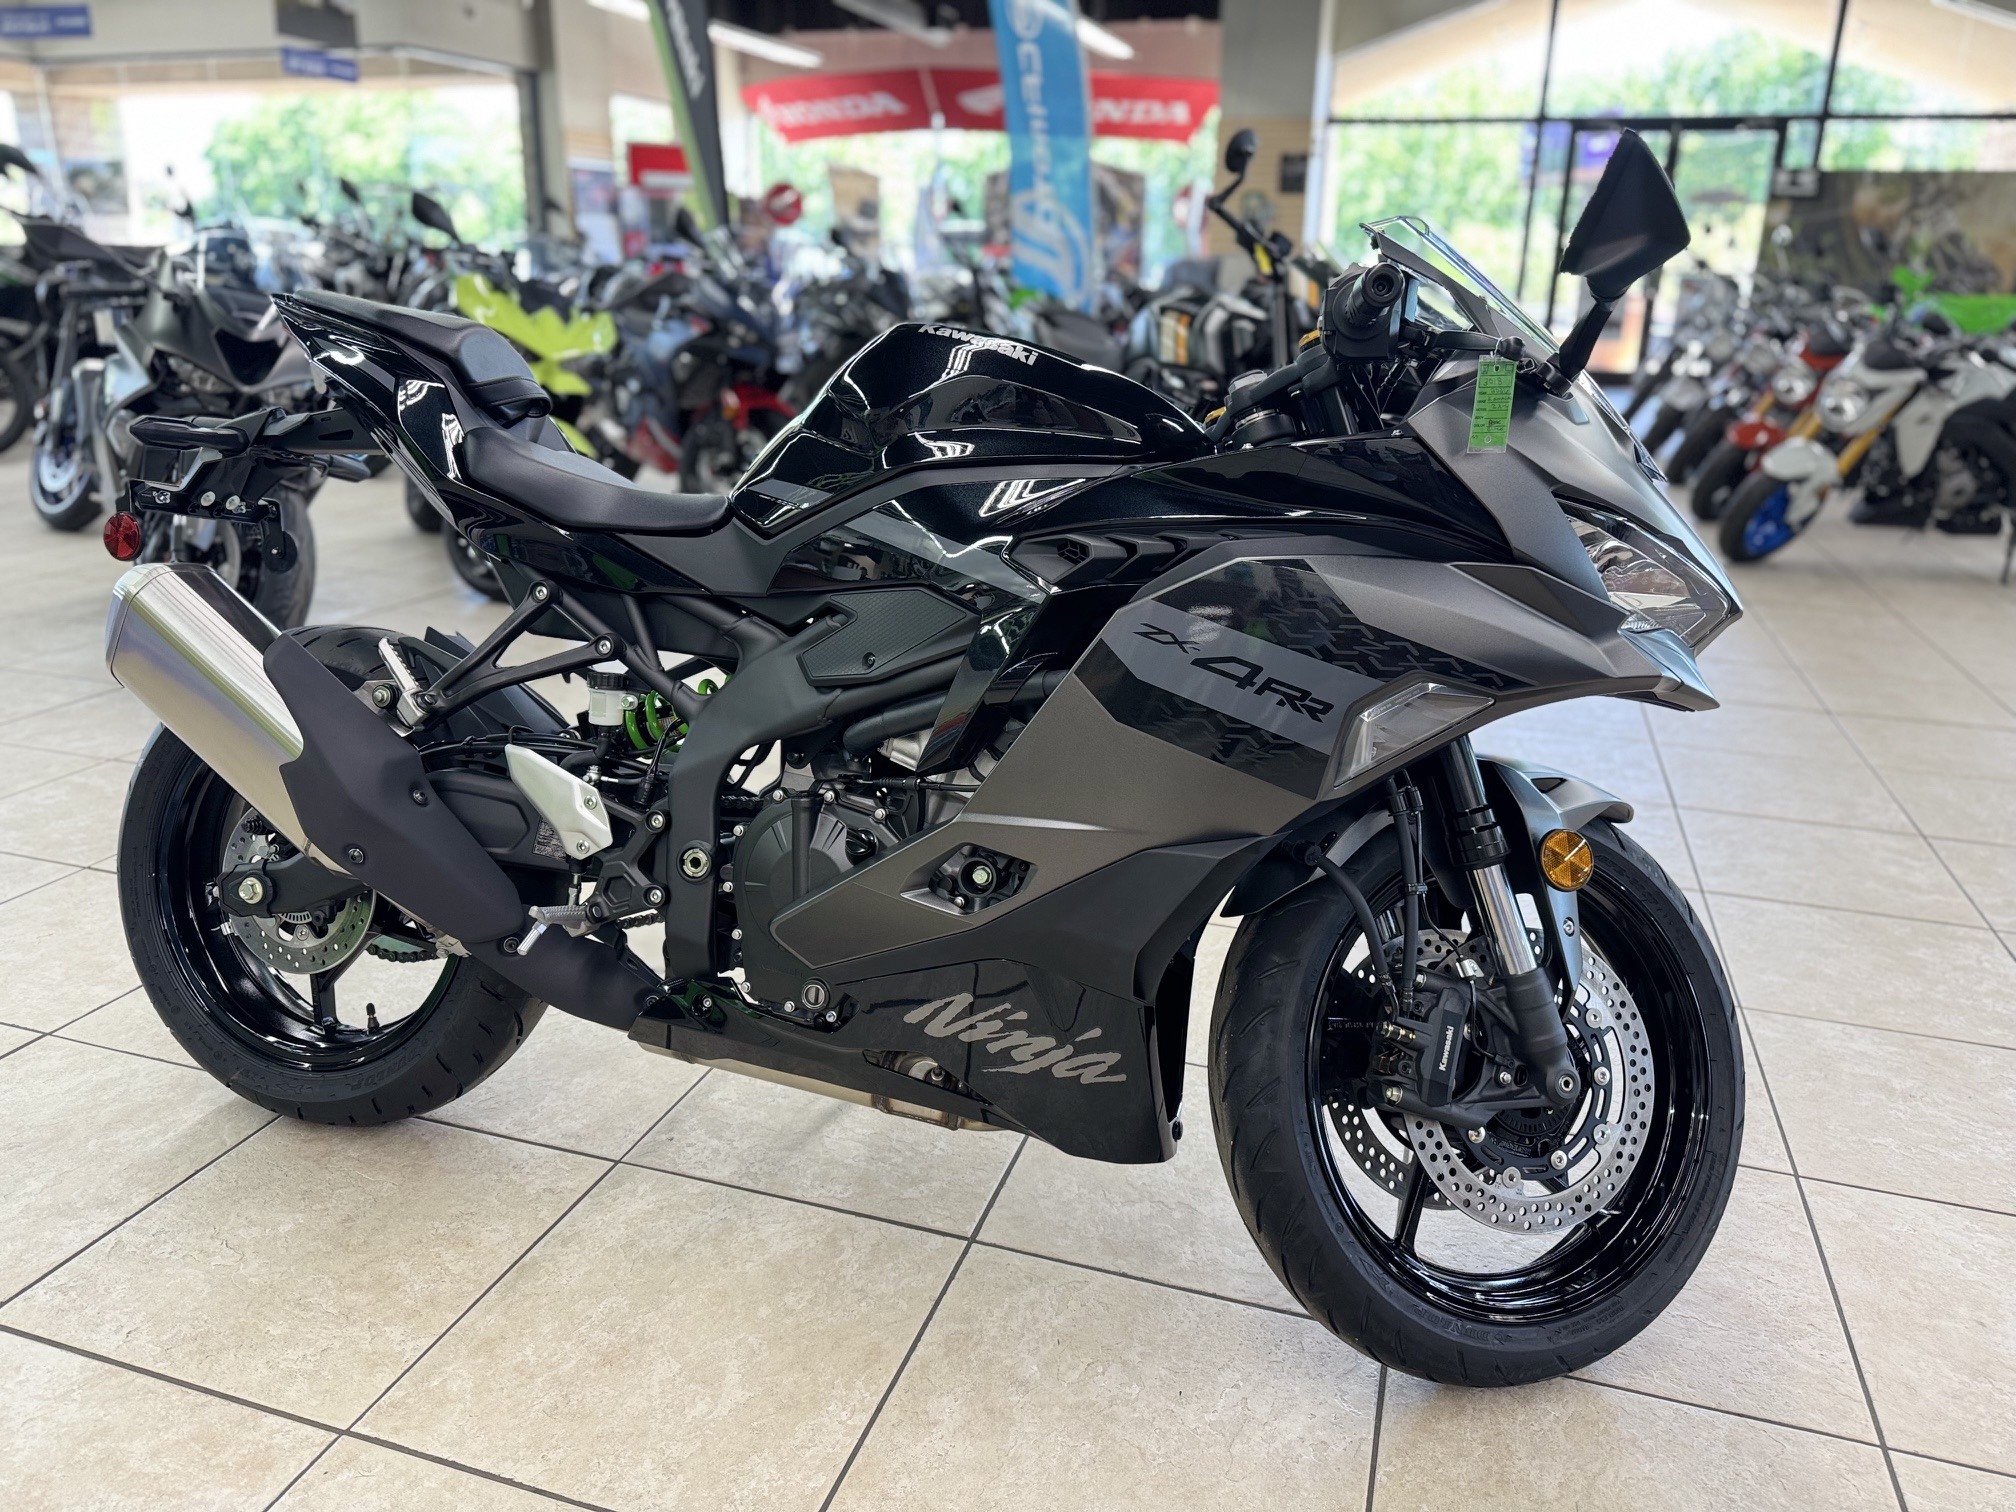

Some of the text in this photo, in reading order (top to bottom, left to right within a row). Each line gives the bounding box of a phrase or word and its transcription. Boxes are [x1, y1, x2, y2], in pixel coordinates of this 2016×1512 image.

[918, 323, 1039, 366] Kawasaki
[903, 992, 1127, 1084] Ninja
[1438, 1025, 1455, 1072] Kawasaki
